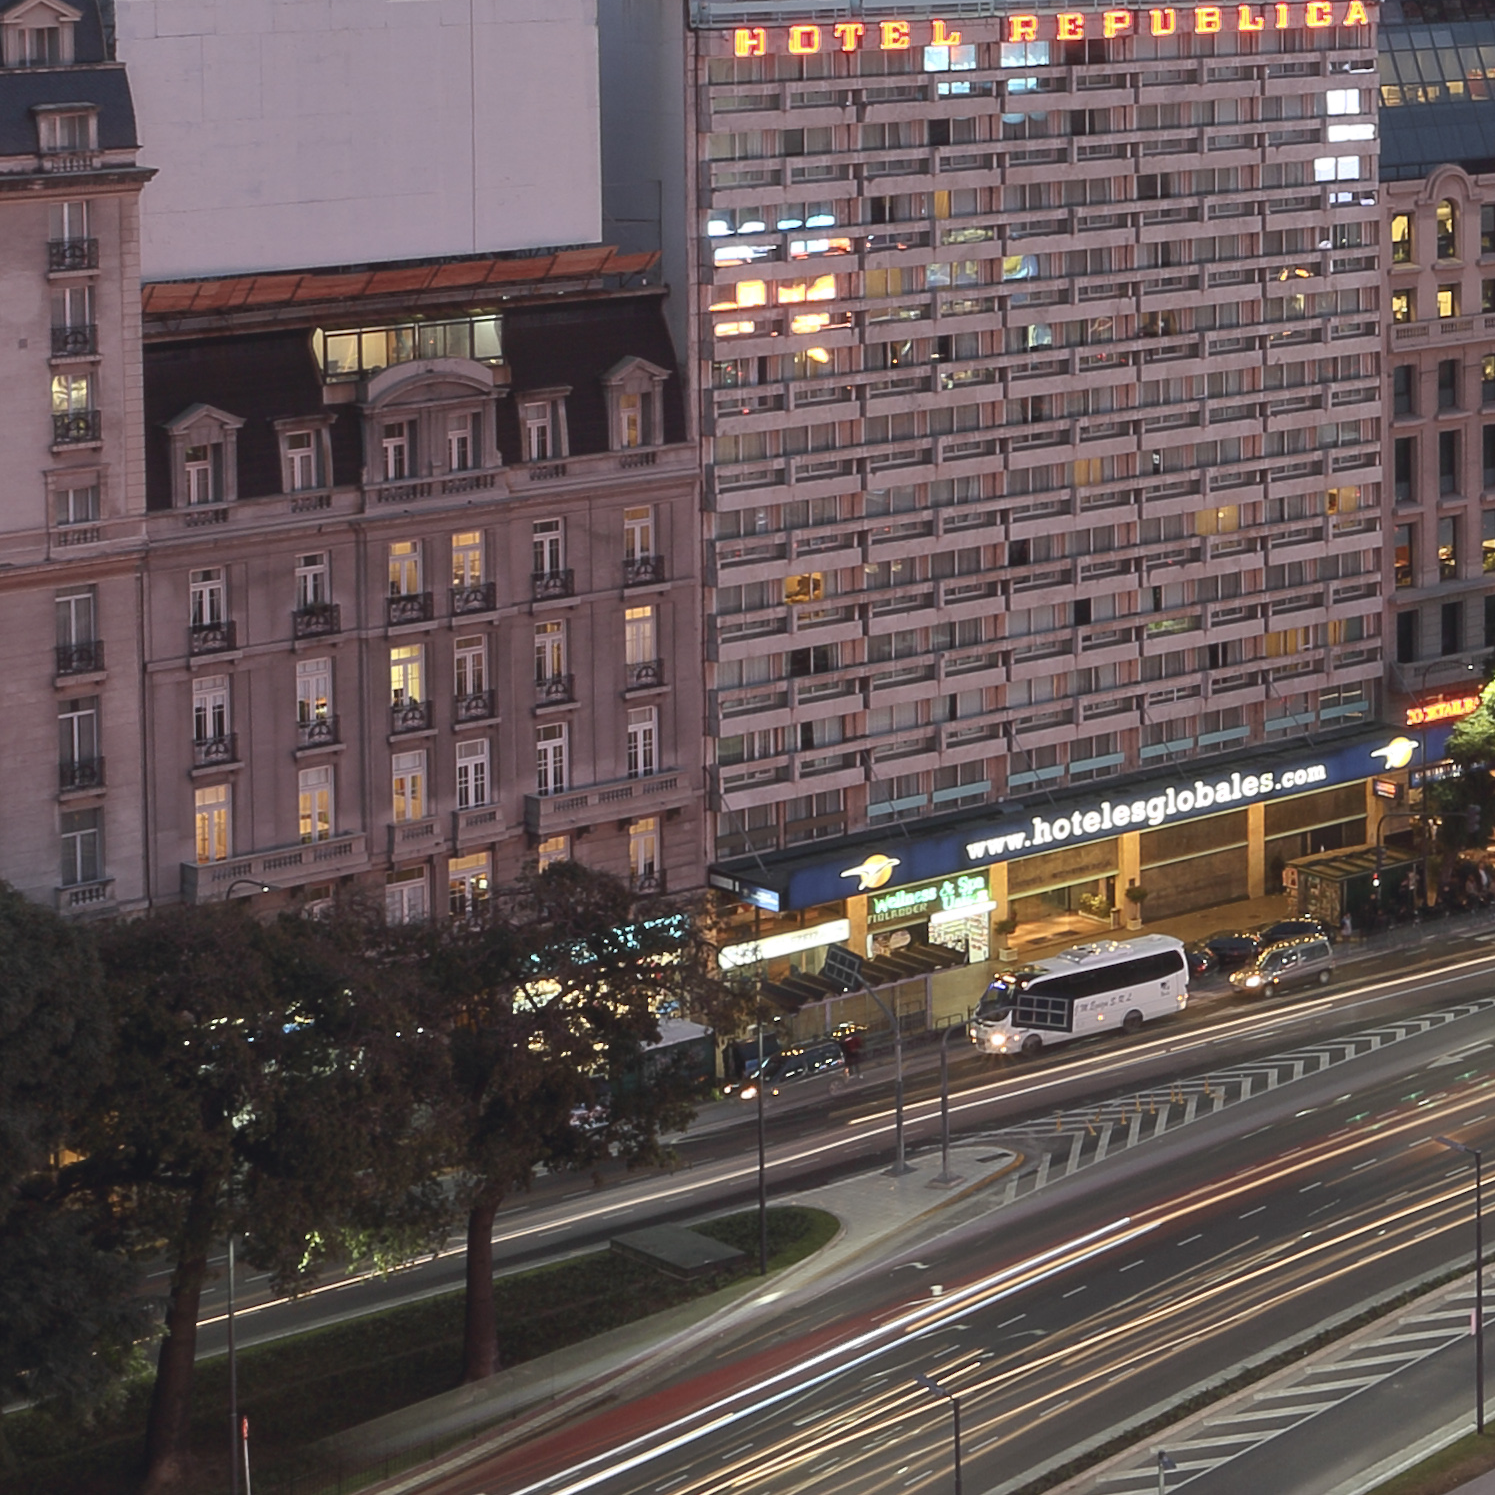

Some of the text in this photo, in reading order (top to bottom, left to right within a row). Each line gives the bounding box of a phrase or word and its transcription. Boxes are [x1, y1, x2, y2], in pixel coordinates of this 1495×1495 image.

[734, 18, 962, 57] HOTEL
[966, 762, 1327, 861] www.hotelesglobales.com
[873, 876, 985, 913] Wellness & Spa
